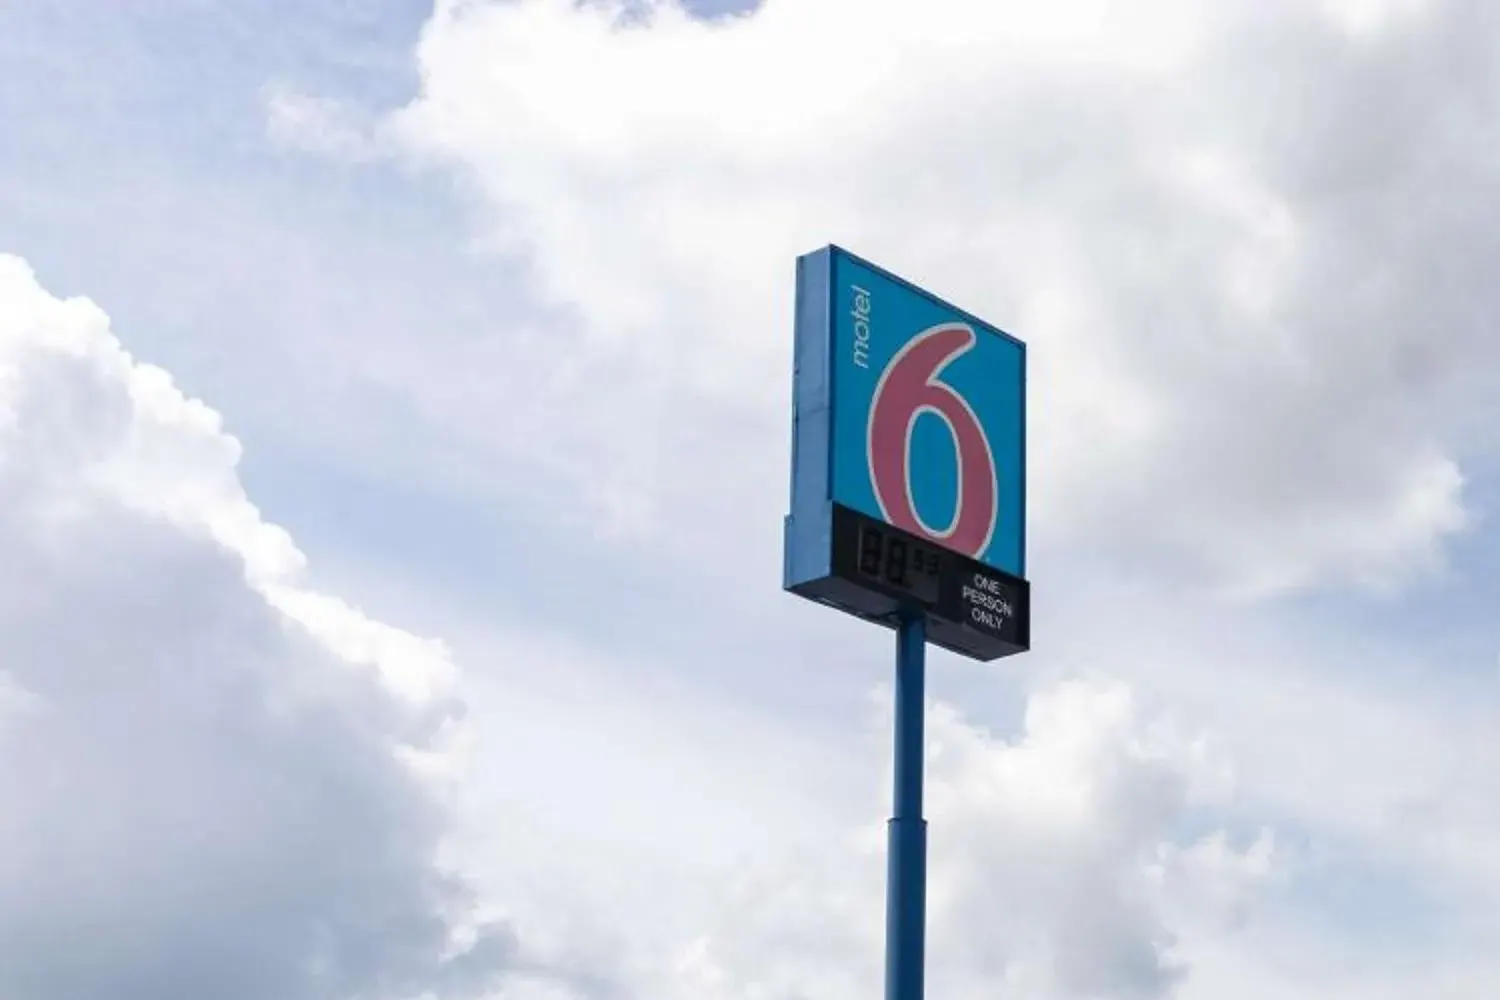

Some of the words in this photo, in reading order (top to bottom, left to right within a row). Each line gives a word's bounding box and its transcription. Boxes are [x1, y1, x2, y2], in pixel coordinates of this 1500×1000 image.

[849, 284, 871, 368] motel
[866, 322, 998, 561] 6
[974, 573, 1001, 595] ONE
[963, 585, 1013, 617] PERSON
[972, 608, 1004, 629] ONLY
